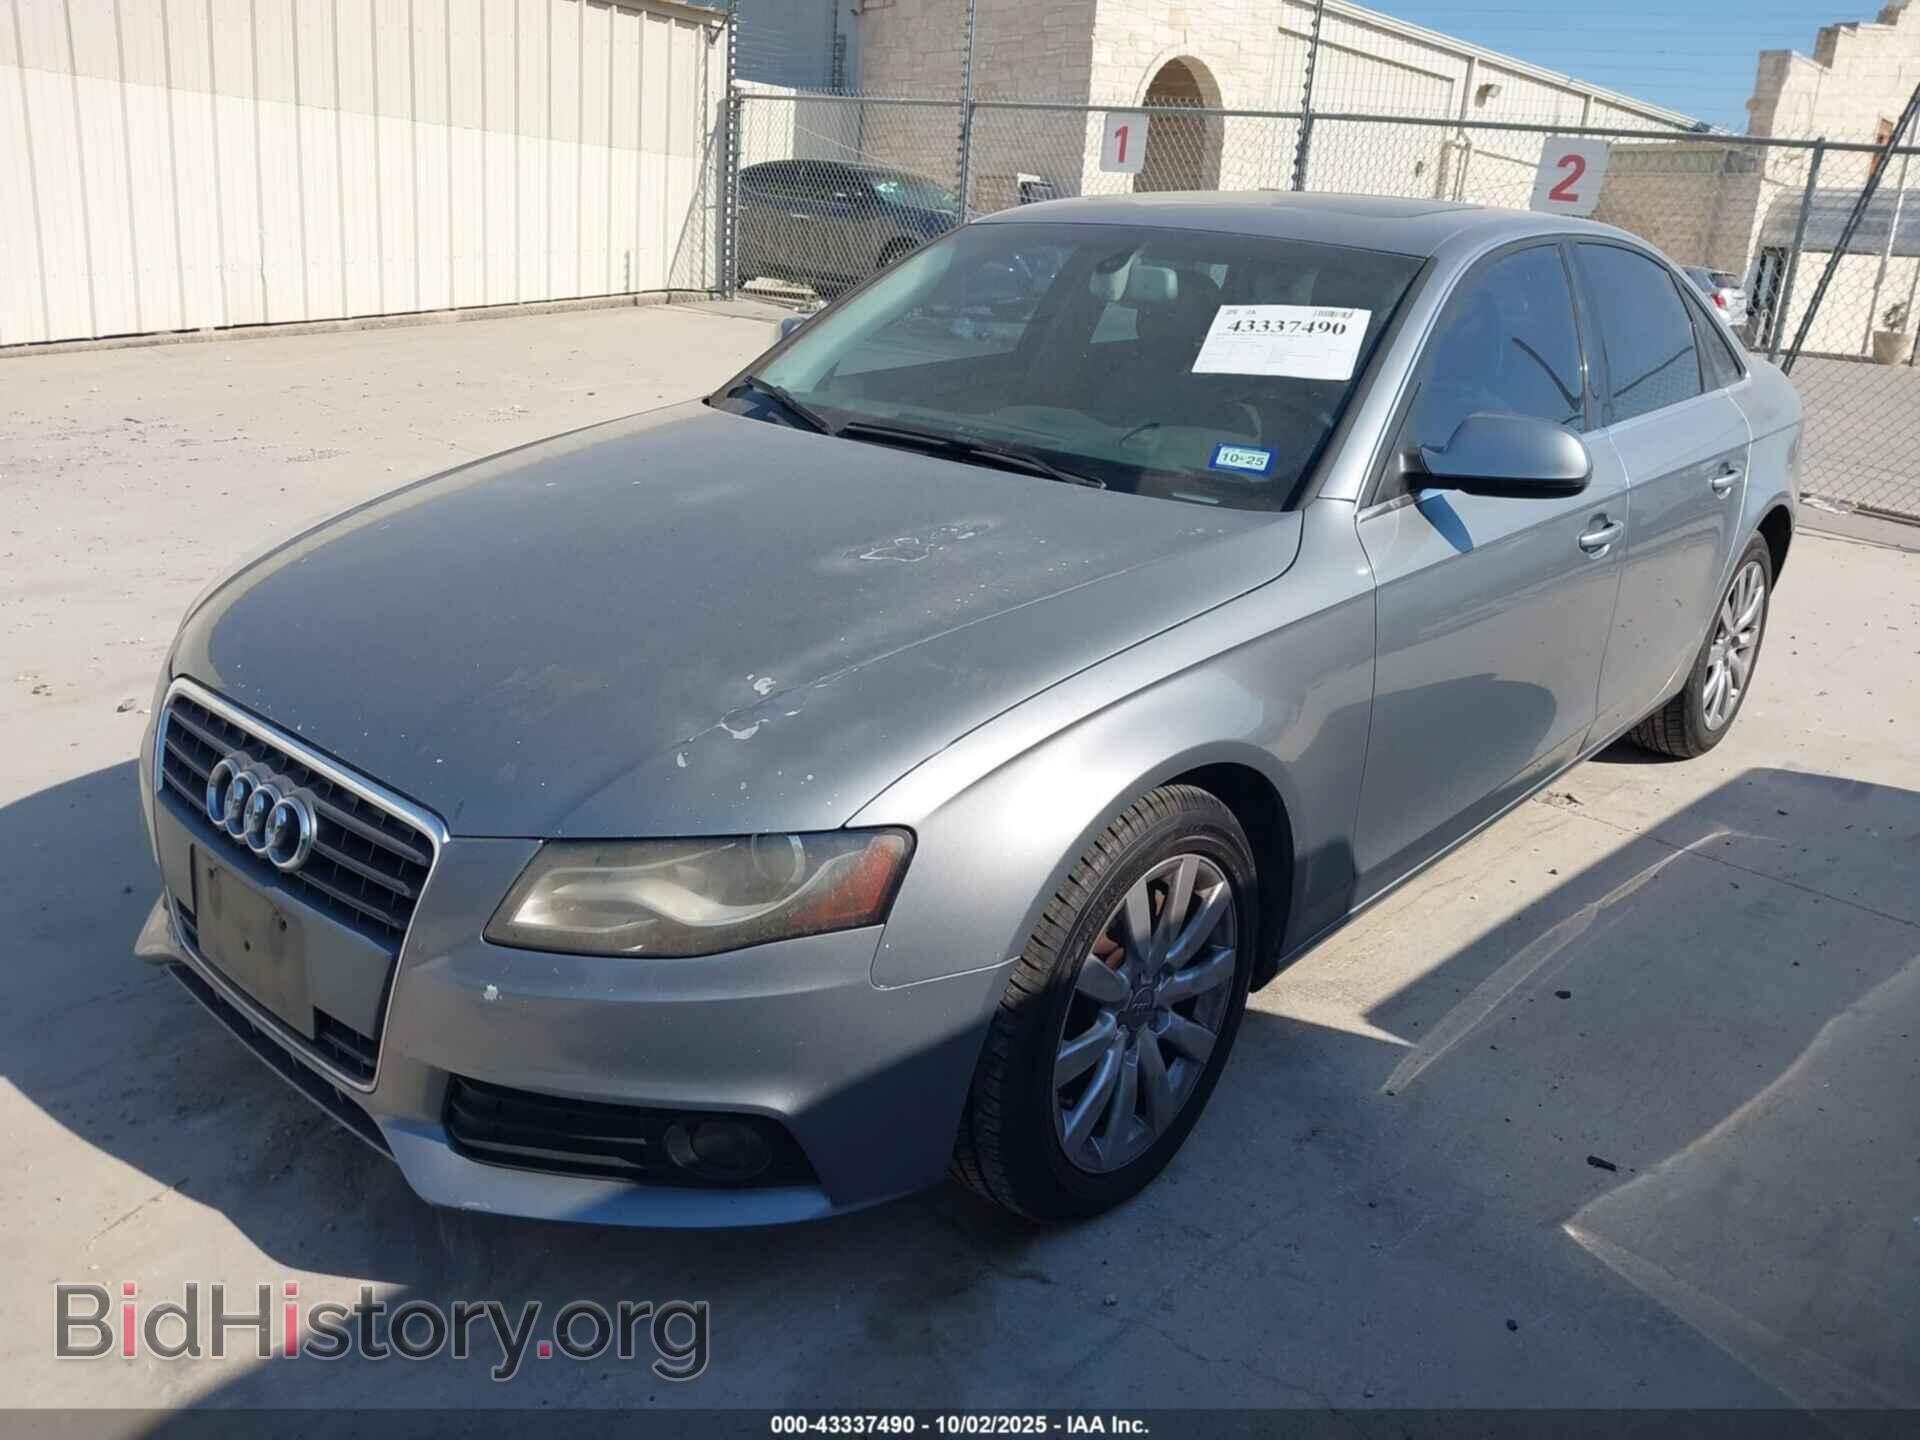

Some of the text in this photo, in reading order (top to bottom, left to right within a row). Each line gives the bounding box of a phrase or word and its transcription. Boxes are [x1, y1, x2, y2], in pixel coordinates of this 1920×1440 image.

[1113, 126, 1129, 163] 1
[1548, 154, 1587, 202] 2
[1227, 320, 1346, 335] 43337490
